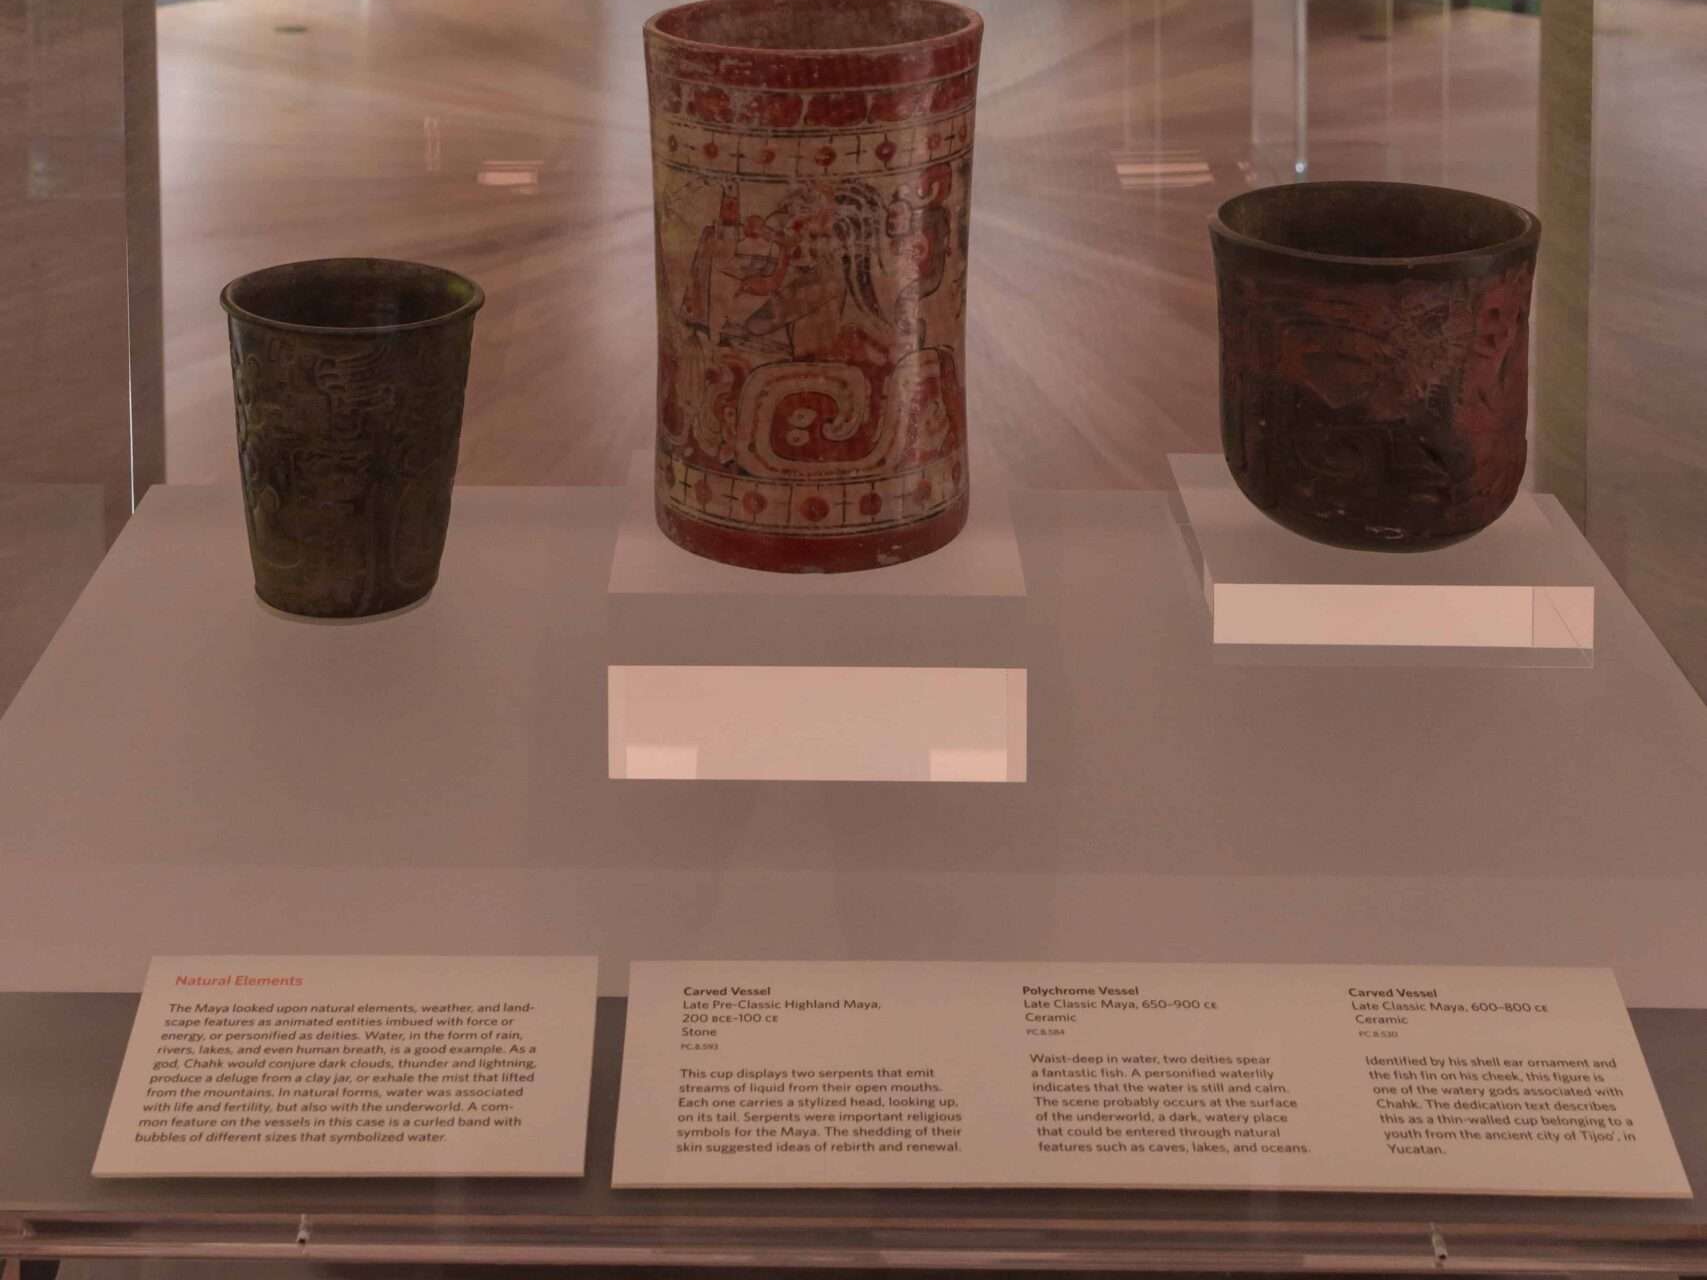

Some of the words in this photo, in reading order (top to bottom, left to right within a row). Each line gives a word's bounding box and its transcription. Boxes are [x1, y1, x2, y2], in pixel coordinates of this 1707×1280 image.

[176, 975, 232, 987] Natural
[234, 975, 304, 987] Elements
[683, 986, 728, 997] Carved
[730, 986, 771, 997] Vessel
[1022, 985, 1096, 998] Polychrome
[1097, 985, 1140, 996] Vessel
[1348, 987, 1394, 999] Carved
[1396, 988, 1437, 999] Vessel
[170, 1002, 193, 1014] The
[194, 1003, 231, 1016] Maya
[232, 1003, 275, 1014] looked
[276, 1005, 309, 1016] upon
[310, 1003, 356, 1014] natural
[357, 1003, 418, 1015] elements,
[420, 1003, 474, 1016] weather,
[477, 1002, 501, 1014] and
[502, 1002, 535, 1013] land-
[682, 998, 710, 1011] Late
[711, 999, 781, 1010] Pre-Classic
[784, 999, 841, 1012] Highland
[843, 999, 881, 1011] Maya,
[1023, 999, 1051, 1009] Late
[1052, 998, 1098, 1009] Classic
[1100, 998, 1139, 1011] Maya,
[1352, 1000, 1379, 1012] Late
[1381, 1000, 1426, 1012] Classic
[1429, 1001, 1468, 1014] Maya,
[164, 1018, 203, 1029] scape
[204, 1016, 256, 1028] features
[257, 1018, 273, 1028] as
[274, 1016, 335, 1028] animated
[335, 1016, 384, 1028] entities
[385, 1016, 434, 1028] imbued
[436, 1015, 465, 1027] with
[467, 1015, 500, 1028] force
[500, 1018, 515, 1027] or
[682, 1012, 709, 1024] 200
[1024, 1012, 1077, 1023] Ceramic
[1355, 1014, 1408, 1025] Ceramic
[681, 1026, 718, 1038] Stone
[1029, 1053, 1104, 1066] Waist-deep
[1106, 1053, 1119, 1065] in
[1121, 1054, 1161, 1067] water,
[1162, 1054, 1188, 1065] two
[1189, 1053, 1233, 1065] deities
[1235, 1056, 1270, 1066] spear
[1365, 1055, 1427, 1067] Identified
[1429, 1056, 1446, 1069] by
[1448, 1056, 1468, 1068] his
[1470, 1056, 1501, 1068] shell
[1504, 1059, 1524, 1069] ear
[1528, 1059, 1590, 1069] ornament
[1593, 1057, 1617, 1069] and
[680, 1068, 707, 1079] This
[709, 1070, 734, 1081] cup
[736, 1068, 789, 1081] displays
[791, 1068, 816, 1079] two
[818, 1069, 874, 1081] serpents
[876, 1067, 903, 1079] that
[905, 1067, 935, 1079] emit
[1031, 1069, 1040, 1079] a
[1041, 1067, 1098, 1079] fantastic
[1100, 1067, 1128, 1079] fish.
[1130, 1067, 1142, 1079] A
[1143, 1067, 1217, 1082] personified
[1218, 1068, 1274, 1081] waterlily
[147, 1087, 178, 1098] from
[180, 1087, 202, 1099] the
[203, 1087, 275, 1099] mountains.
[277, 1087, 291, 1098] In
[293, 1086, 340, 1098] natural
[341, 1086, 384, 1099] forms,
[386, 1086, 424, 1099] water
[426, 1088, 452, 1098] was
[455, 1086, 524, 1098] associated
[1373, 1085, 1398, 1096] one
[1399, 1084, 1414, 1096] of
[1416, 1084, 1438, 1096] the
[1441, 1086, 1485, 1099] watery
[1487, 1085, 1520, 1098] gods
[1523, 1086, 1592, 1097] associated
[1594, 1086, 1623, 1097] with
[1035, 1096, 1060, 1108] The
[1061, 1098, 1101, 1108] scene
[1102, 1096, 1161, 1110] probably
[1162, 1098, 1207, 1109] occurs
[1208, 1097, 1223, 1109] at
[1224, 1096, 1248, 1109] the
[1248, 1097, 1298, 1109] surface
[1376, 1098, 1422, 1110] Chahk.
[1425, 1098, 1451, 1111] The
[1453, 1099, 1522, 1111] dedication
[1524, 1100, 1551, 1112] text
[1554, 1100, 1616, 1112] describes
[138, 1119, 169, 1128] mon
[171, 1116, 218, 1128] feature
[219, 1118, 238, 1128] on
[240, 1116, 262, 1128] the
[265, 1116, 312, 1128] vessels
[313, 1117, 326, 1128] in
[329, 1116, 353, 1128] this
[356, 1118, 386, 1128] case
[387, 1116, 401, 1128] is
[402, 1118, 412, 1128] a
[413, 1116, 456, 1128] curled
[458, 1115, 492, 1128] band
[494, 1115, 522, 1128] with
[677, 1113, 694, 1123] on
[697, 1111, 713, 1123] its
[715, 1111, 739, 1123] tail.
[743, 1111, 801, 1124] Serpents
[803, 1112, 836, 1123] were
[838, 1111, 904, 1124] important
[906, 1111, 962, 1124] religious
[135, 1131, 188, 1143] bubbles
[188, 1131, 205, 1143] of
[206, 1131, 263, 1143] different
[265, 1131, 297, 1143] sizes
[300, 1131, 327, 1143] that
[329, 1131, 405, 1144] symbolized
[408, 1132, 447, 1143] water.
[676, 1126, 731, 1140] symbols
[734, 1126, 753, 1138] for
[755, 1126, 777, 1138] the
[780, 1126, 820, 1140] Maya.
[824, 1125, 849, 1137] The
[852, 1126, 913, 1139] shedding
[914, 1125, 928, 1137] of
[931, 1126, 962, 1137] their
[1036, 1126, 1064, 1137] that
[1066, 1126, 1104, 1137] could
[1105, 1126, 1123, 1139] be
[1124, 1126, 1177, 1138] entered
[1178, 1126, 1232, 1140] through
[1233, 1127, 1281, 1139] natural
[676, 1141, 703, 1153] skin
[705, 1142, 773, 1155] suggested
[776, 1141, 811, 1153] ideas
[813, 1141, 828, 1153] of
[830, 1141, 876, 1153] rebirth
[878, 1141, 904, 1153] and
[906, 1141, 961, 1153] renewal.
[1388, 1143, 1445, 1155] Yucatan.
